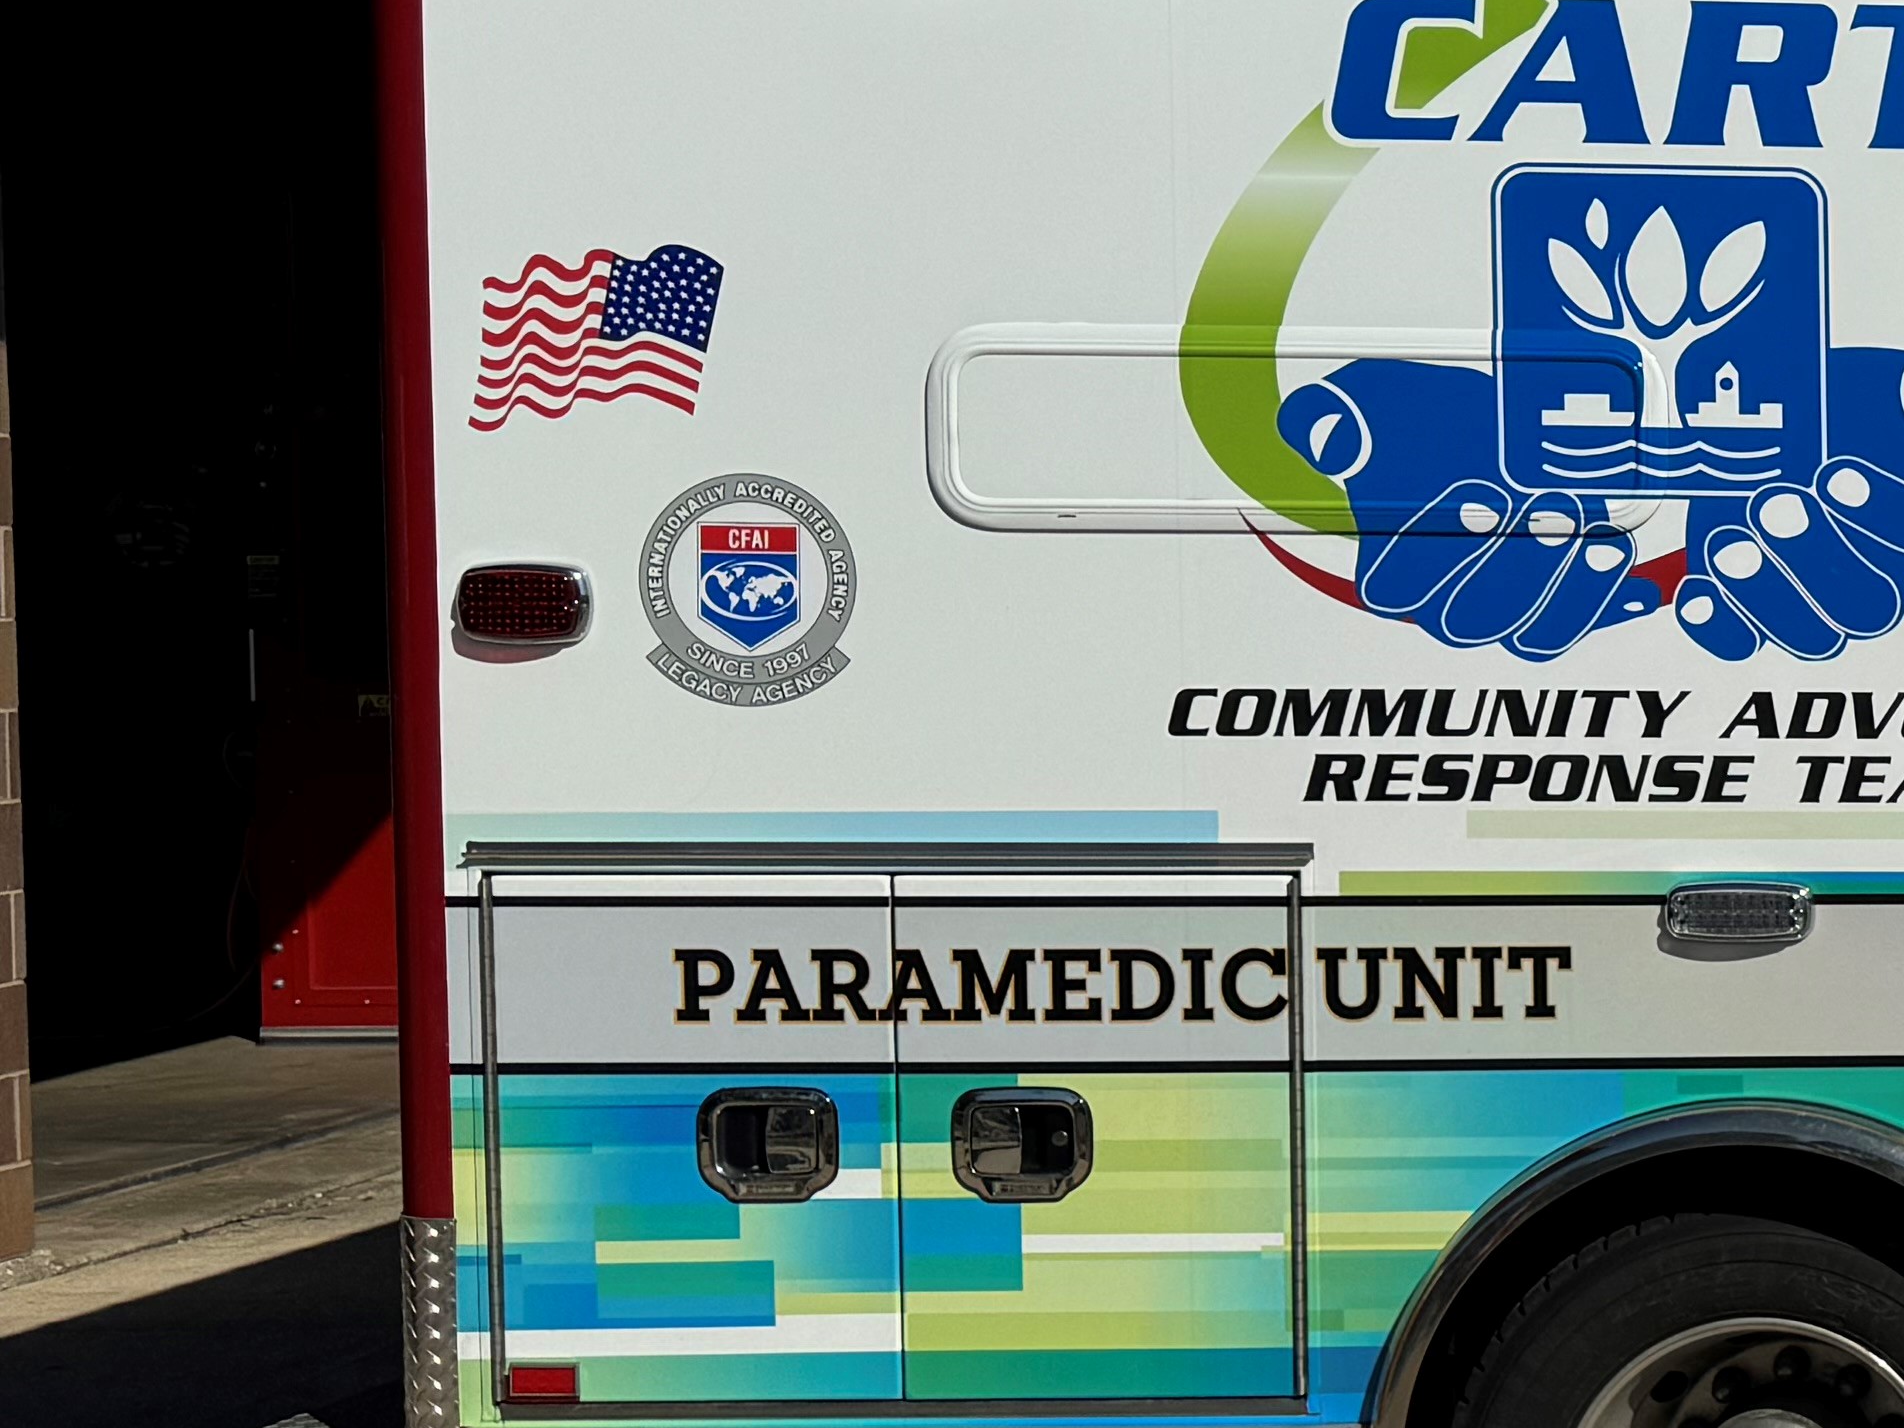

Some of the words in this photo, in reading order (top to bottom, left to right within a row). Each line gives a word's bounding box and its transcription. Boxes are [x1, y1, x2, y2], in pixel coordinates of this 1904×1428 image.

[647, 482, 726, 619] INTERNATIONALLY
[735, 481, 836, 543] ACCREDITED
[827, 549, 849, 622] AGENCY
[729, 529, 769, 549] CFAI
[657, 653, 743, 703] LEGACY
[752, 657, 839, 704] AGENCY
[687, 643, 755, 679] SINCE
[765, 644, 810, 677] 1997
[1167, 688, 1690, 739] COMMUNITY
[1303, 755, 1754, 803] RESPONSE
[672, 946, 1289, 1025] PARAMEDIC
[1317, 945, 1573, 1022] UNIT
